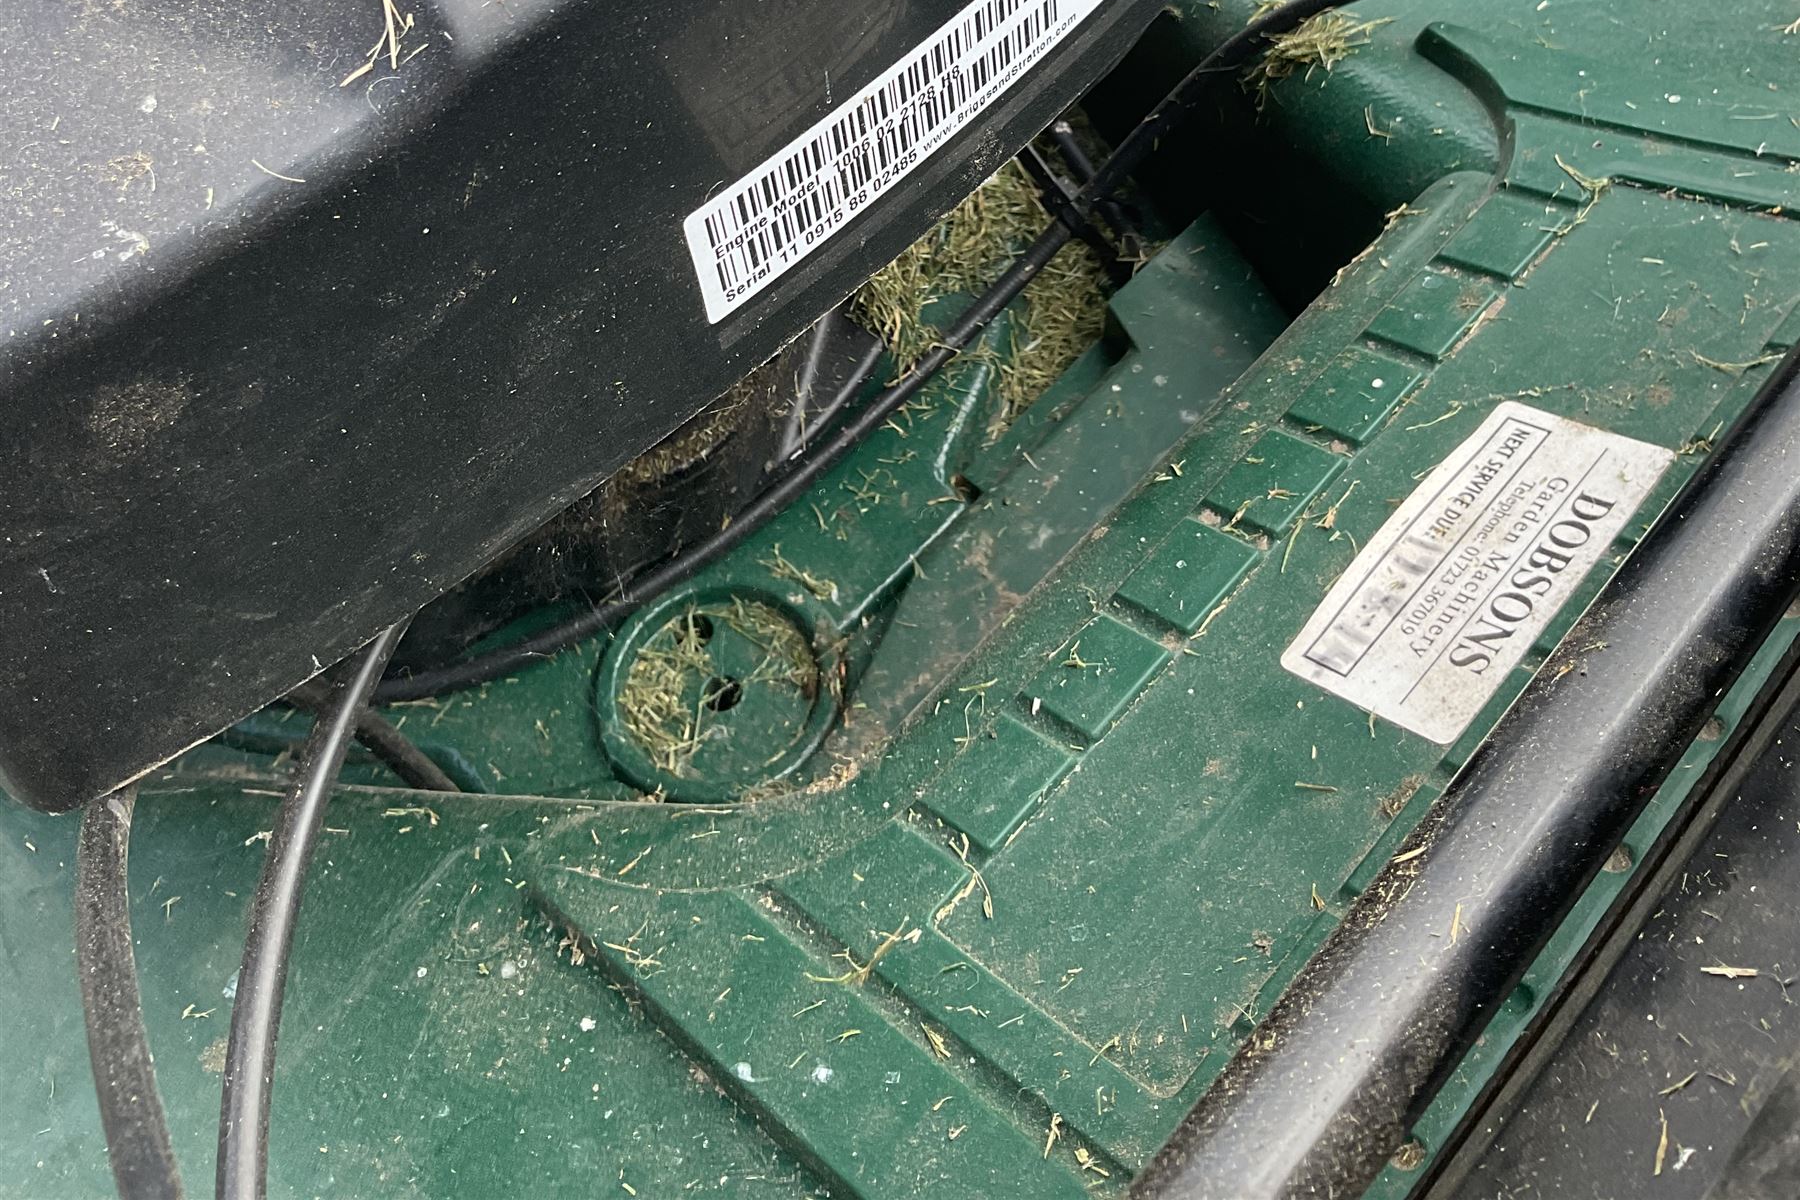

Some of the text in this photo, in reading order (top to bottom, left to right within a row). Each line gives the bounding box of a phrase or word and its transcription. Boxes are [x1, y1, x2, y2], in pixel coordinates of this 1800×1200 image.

[923, 13, 1077, 152] www.BriggsandStratton.com
[715, 215, 768, 260] Engine
[773, 174, 820, 218] Model
[833, 138, 870, 172] 1006
[877, 119, 895, 143] 02
[900, 85, 935, 119] 2128
[726, 152, 917, 302] Serial 11 0915 88 02485
[1452, 459, 1503, 509] SERVICE
[1496, 428, 1531, 459] NEXT
[1401, 585, 1446, 635] 367019
[1409, 477, 1569, 658] Garden Machinery
[1440, 546, 1480, 585] 01723
[1449, 491, 1616, 675] DOBSONS
